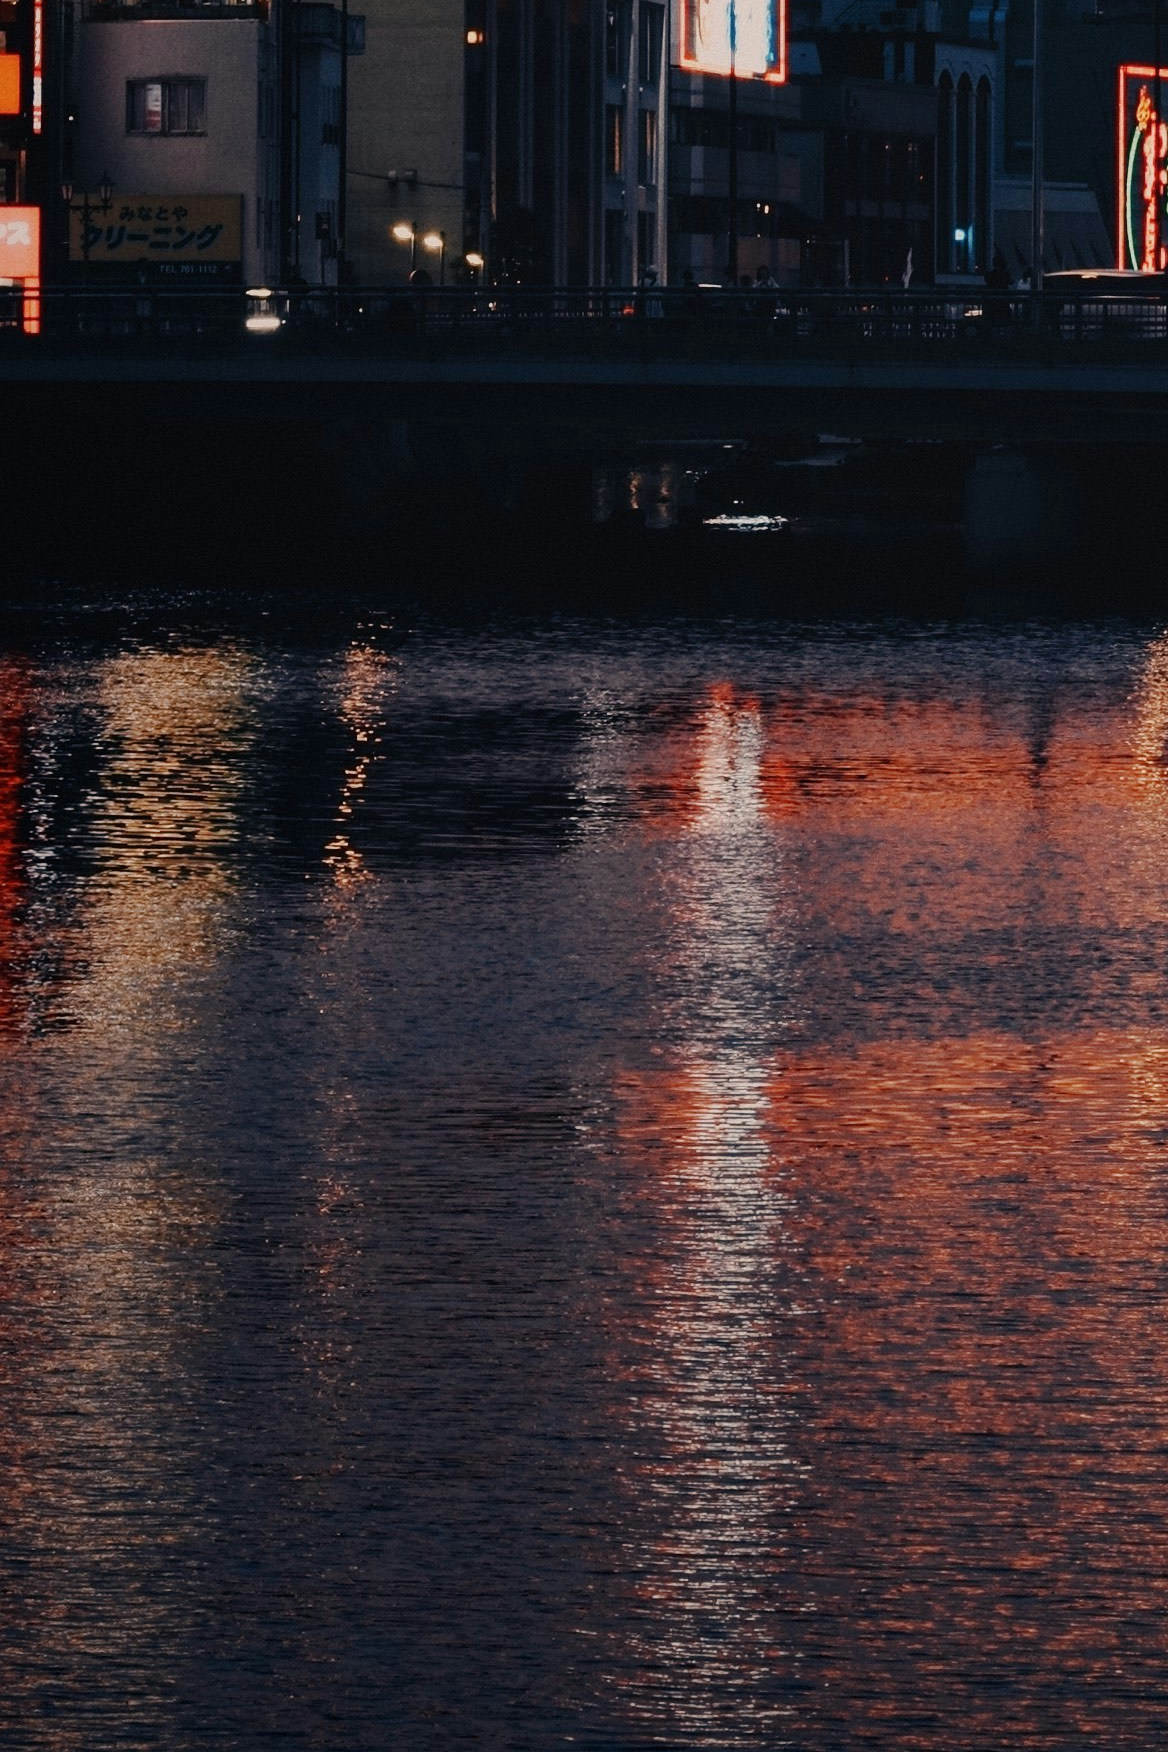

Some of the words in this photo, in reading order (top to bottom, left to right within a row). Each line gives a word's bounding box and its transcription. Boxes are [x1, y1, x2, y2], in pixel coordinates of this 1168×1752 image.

[119, 205, 188, 222] みなとや
[81, 223, 224, 250] クリーニング
[160, 265, 176, 274] TEL
